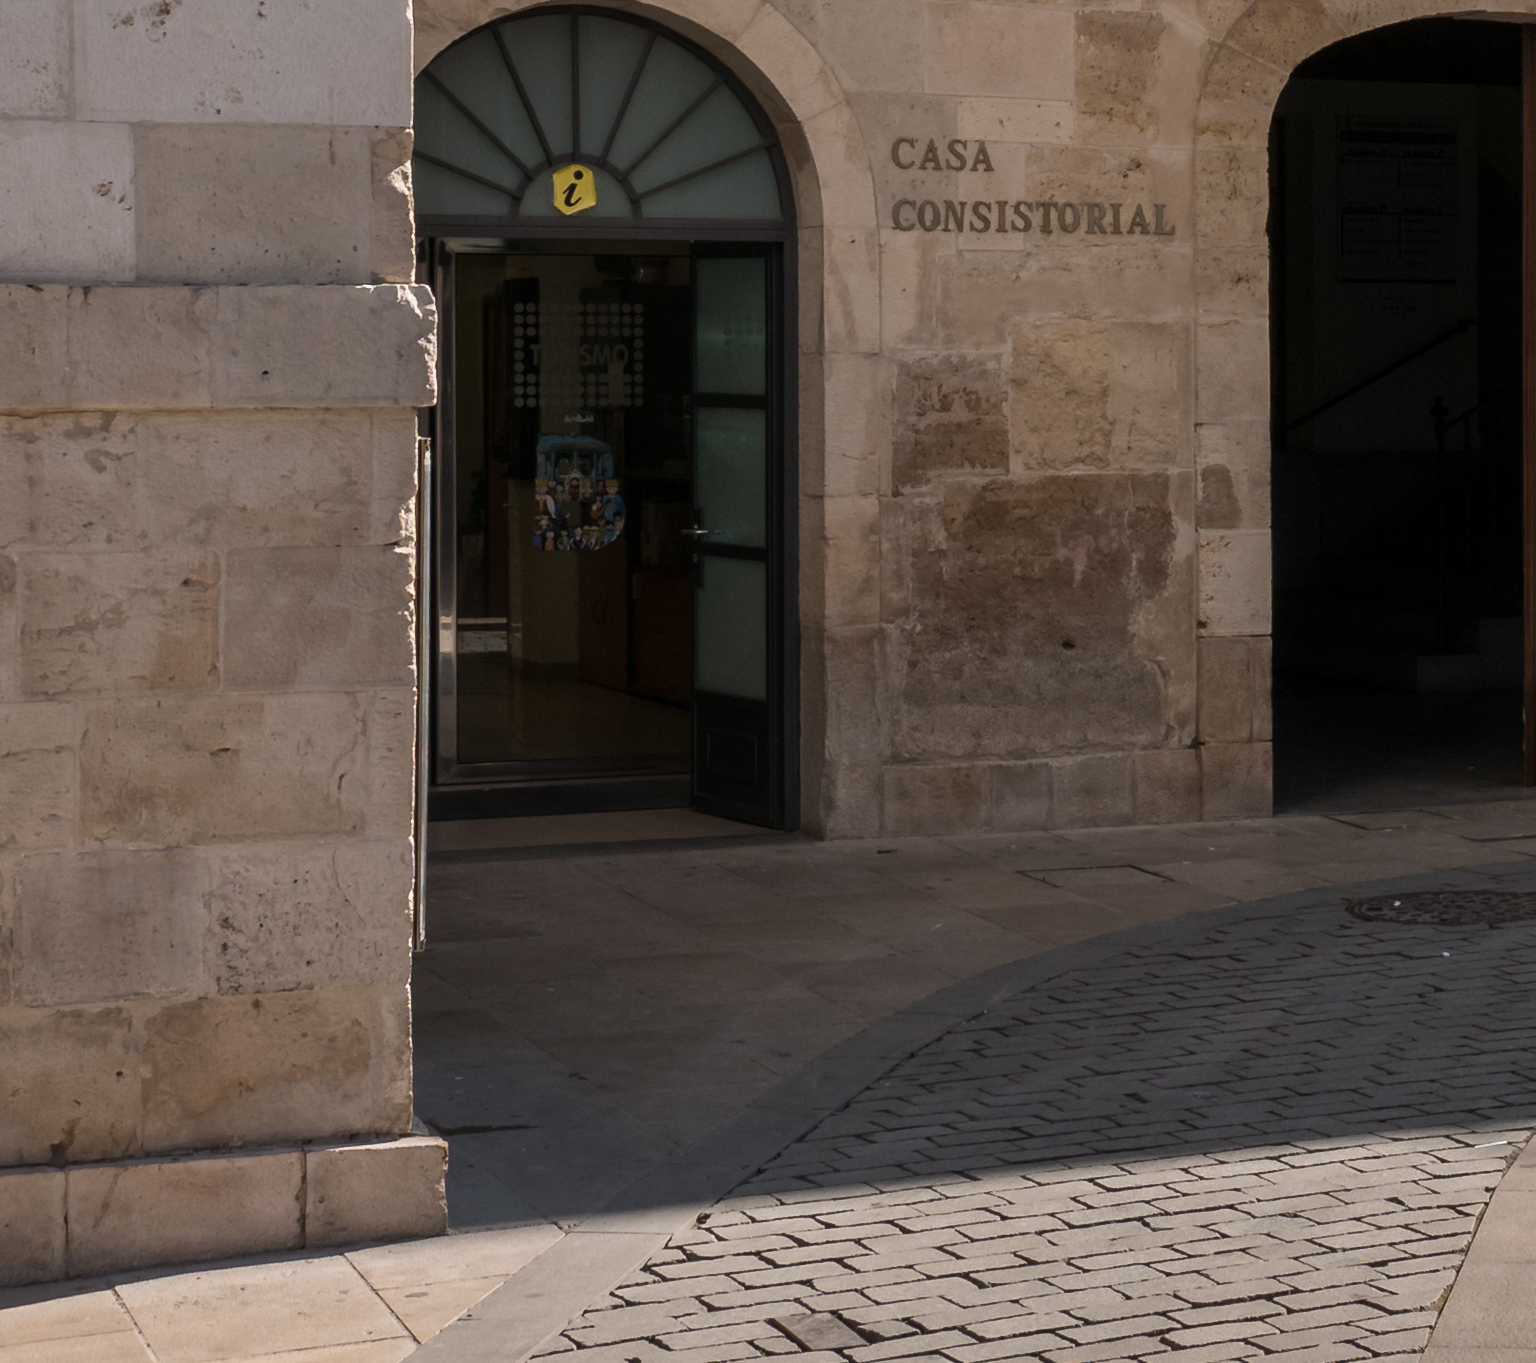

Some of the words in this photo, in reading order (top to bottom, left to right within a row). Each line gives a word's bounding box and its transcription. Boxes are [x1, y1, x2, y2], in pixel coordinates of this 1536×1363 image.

[891, 137, 995, 172] CASA
[891, 198, 1176, 236] CONSISTORIAL
[529, 343, 629, 367] TURSMO
